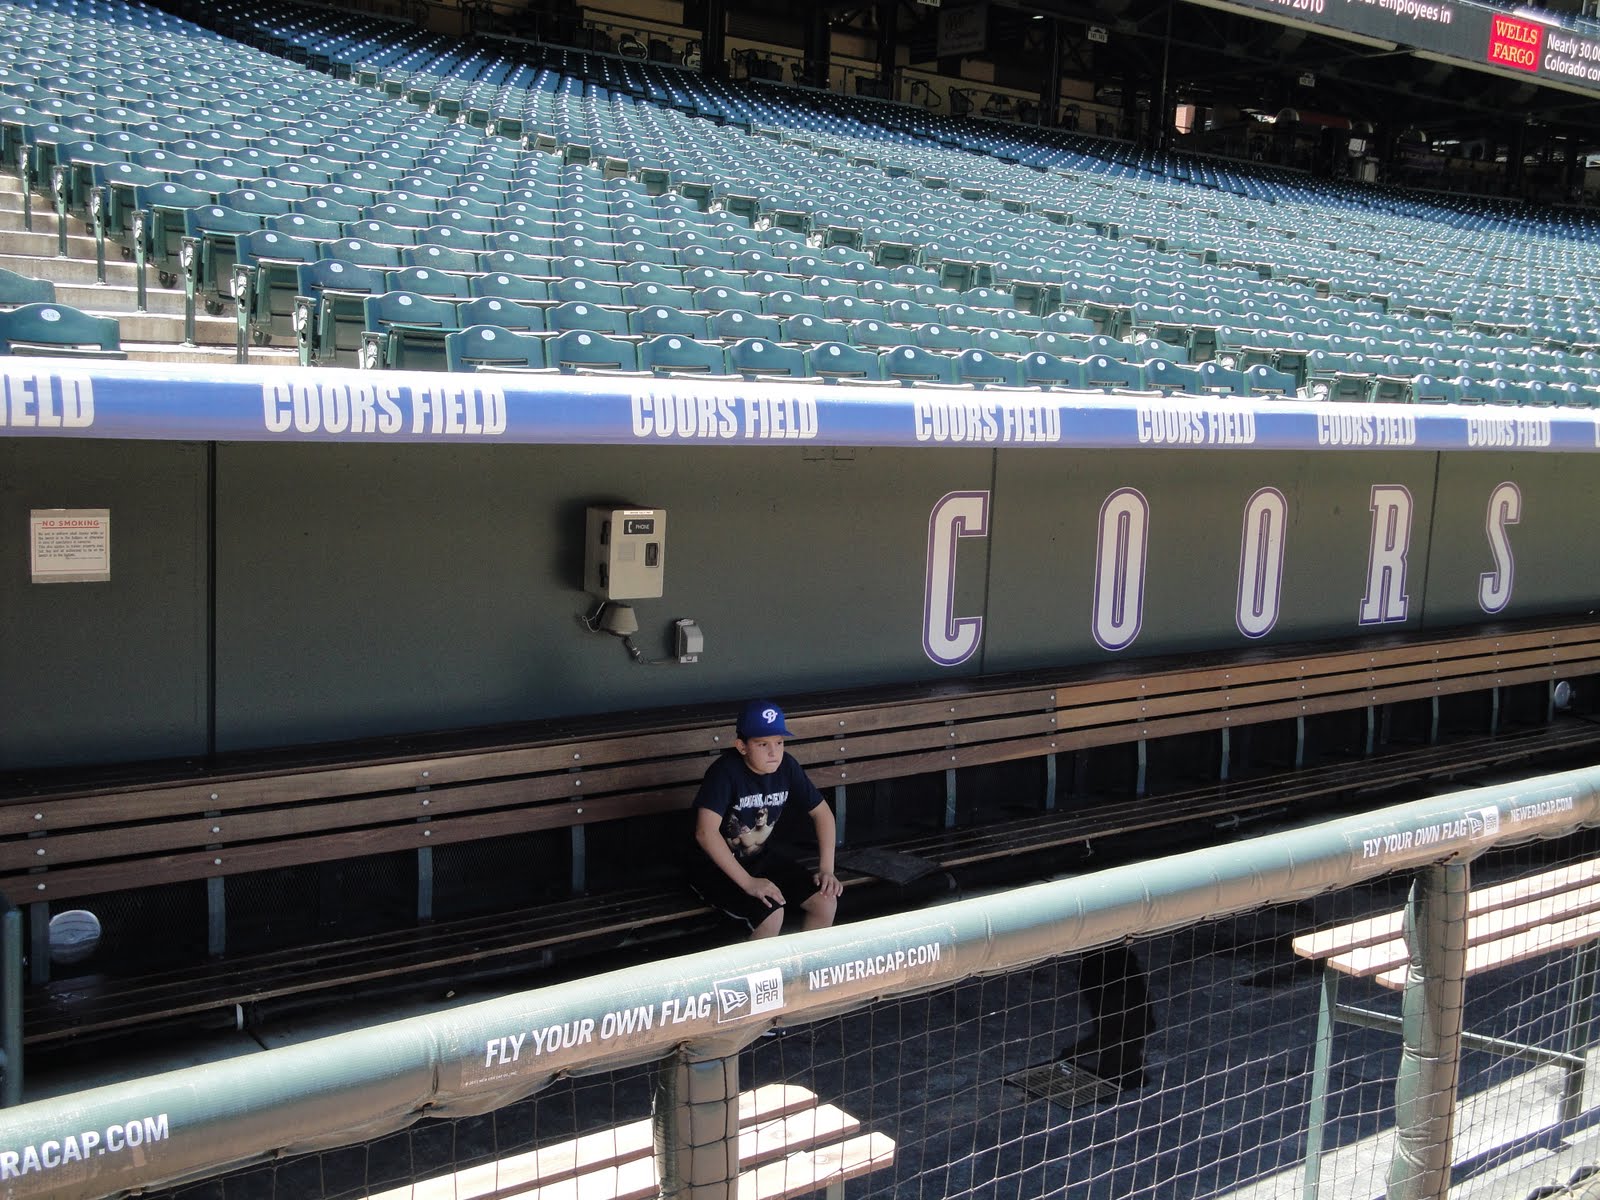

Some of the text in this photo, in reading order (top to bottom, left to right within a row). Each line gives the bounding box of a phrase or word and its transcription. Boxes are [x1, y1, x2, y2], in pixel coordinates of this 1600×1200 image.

[1379, 0, 1451, 23] employees in
[1496, 20, 1538, 45] WELLS
[1547, 34, 1578, 58] Nearly
[1493, 42, 1535, 65] FARGO
[1545, 55, 1586, 78] Colorado
[263, 381, 507, 435] COORS FIELD
[631, 392, 818, 440] COORS FIELD
[914, 400, 1061, 443] COORS FIELD
[1137, 404, 1256, 445] COORS FIELD
[1317, 411, 1416, 446] COORS FIELD
[1467, 415, 1551, 447] COORS FIELD
[635, 523, 650, 531] PHONE
[1510, 797, 1573, 823] NEWERACAP.COM
[1362, 839, 1381, 859] FLY
[1382, 831, 1412, 852] YOUR
[1414, 824, 1441, 846] OWN
[1441, 819, 1468, 840] FLAG
[808, 942, 941, 992] NEWERACAP.COM
[755, 978, 779, 994] NEW
[756, 990, 779, 1005] ERA
[485, 993, 712, 1068] FLY YOUR OWN FLAG
